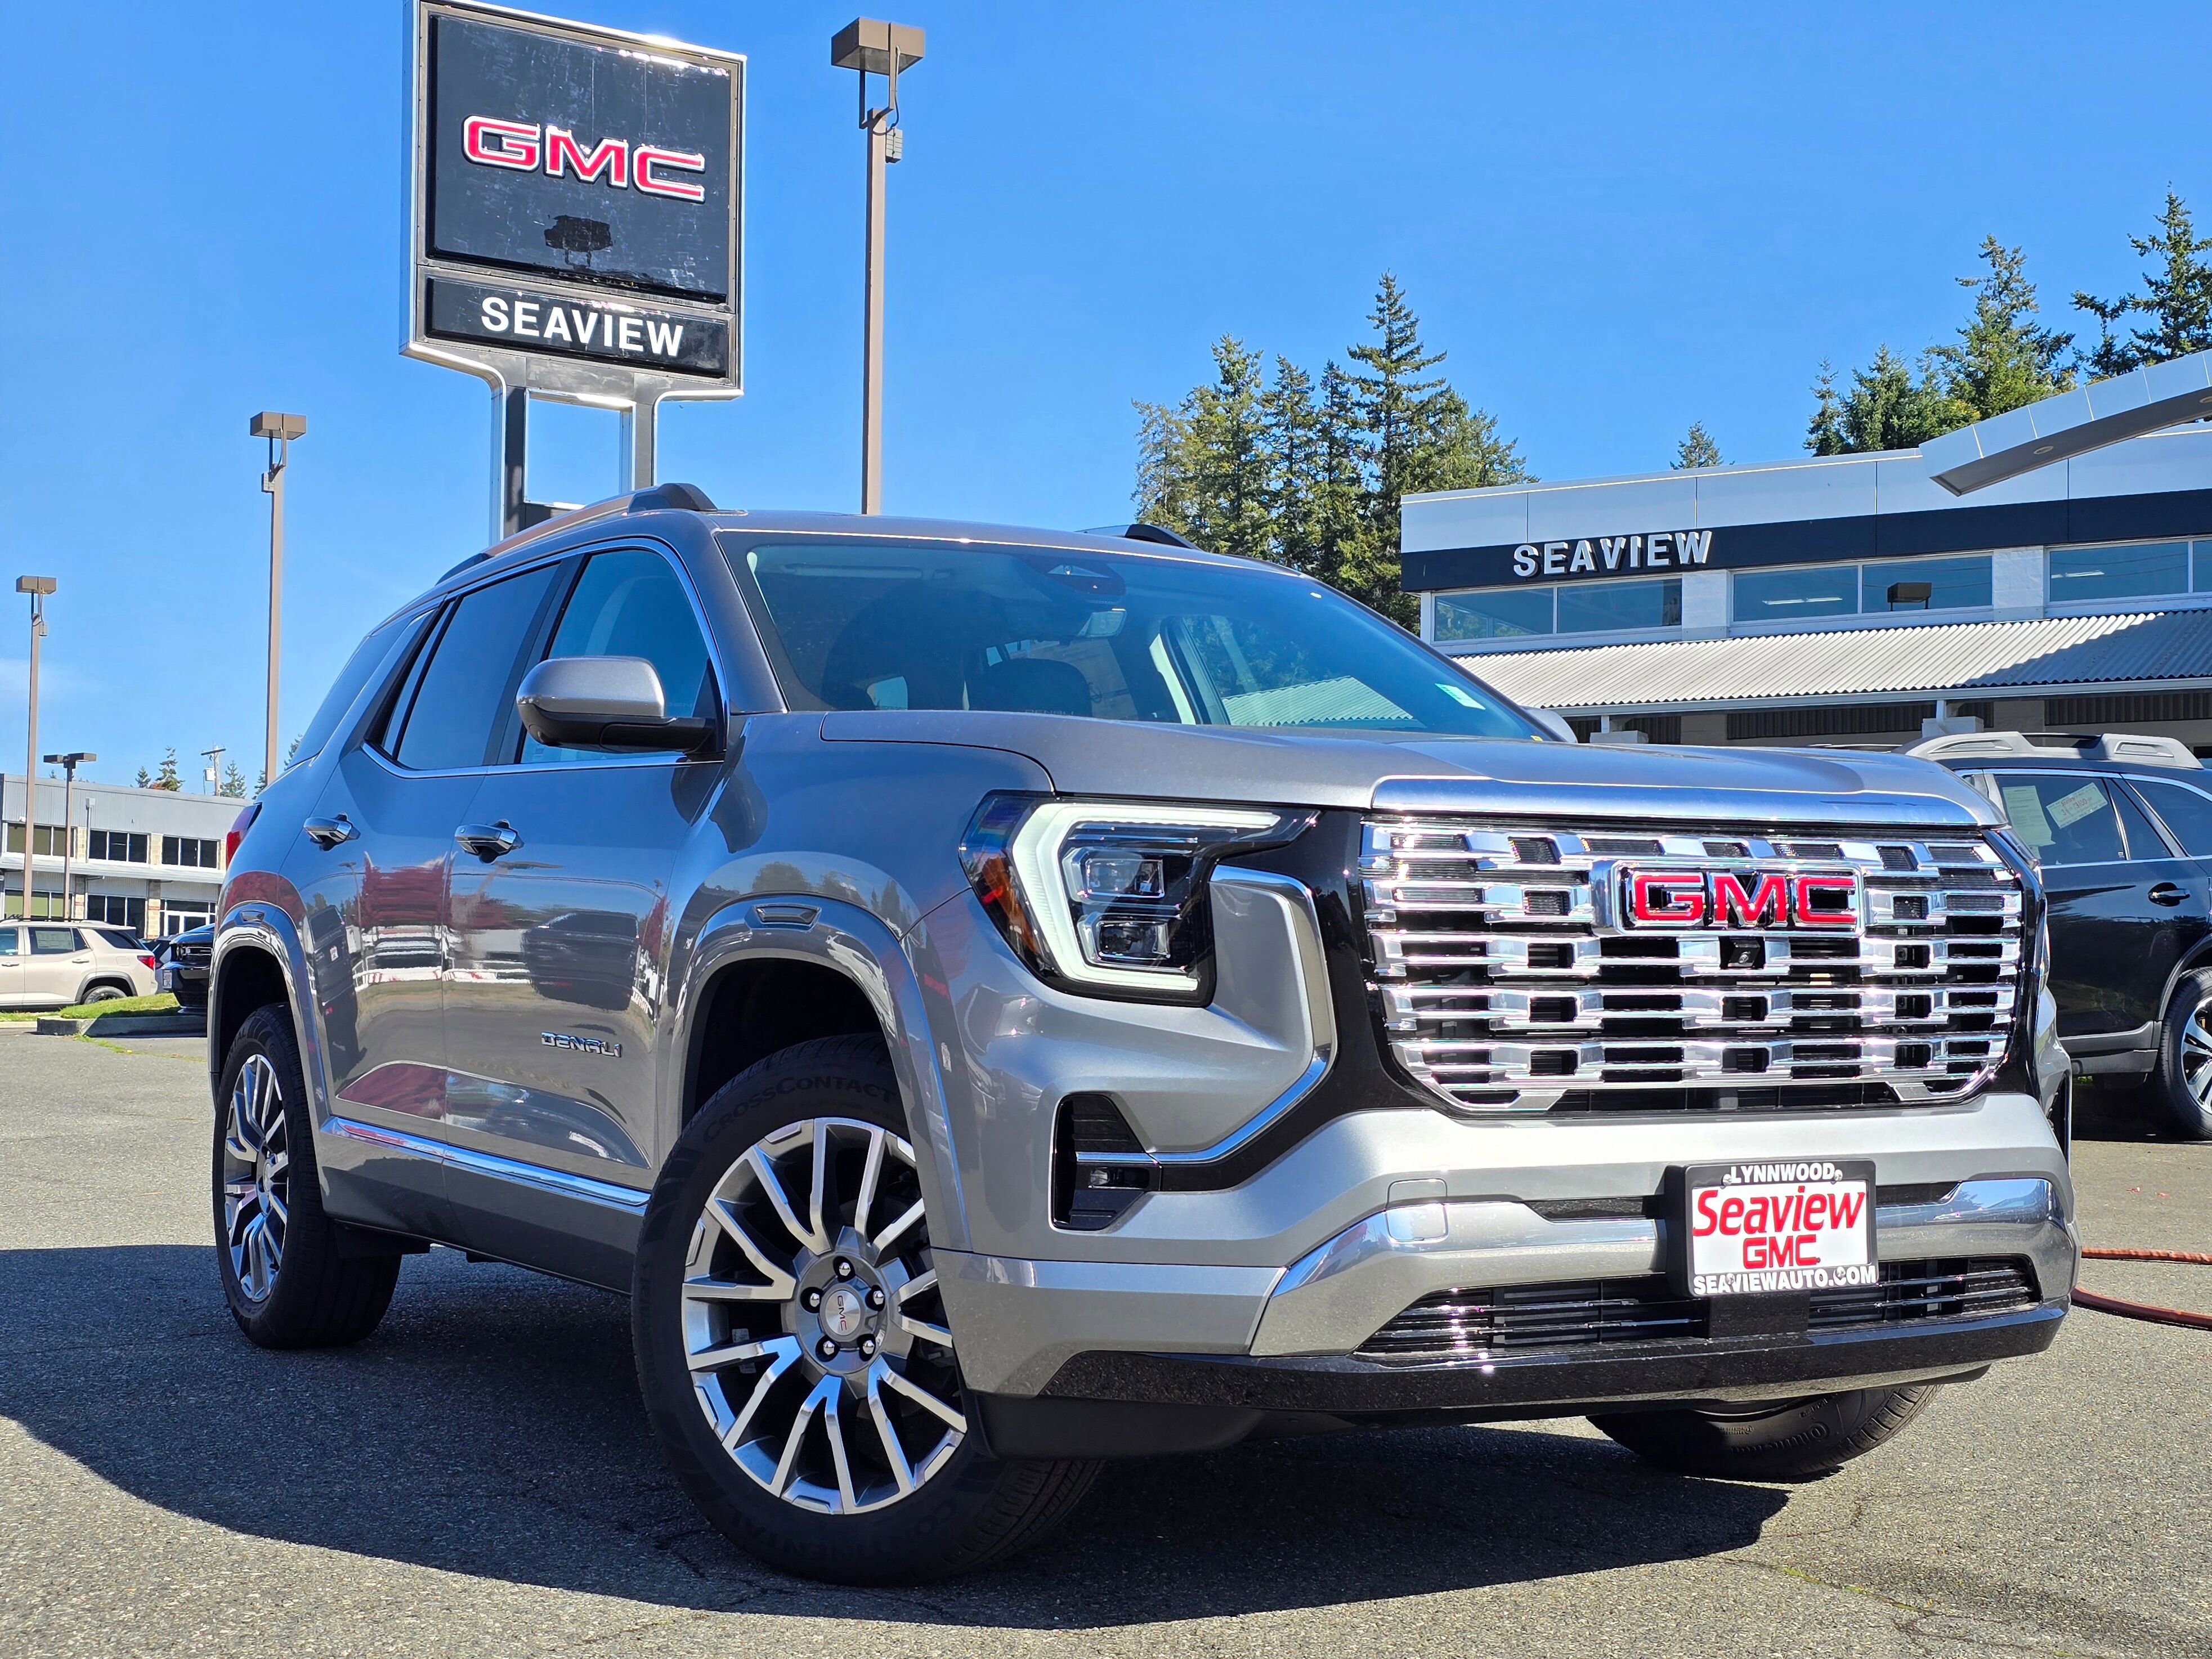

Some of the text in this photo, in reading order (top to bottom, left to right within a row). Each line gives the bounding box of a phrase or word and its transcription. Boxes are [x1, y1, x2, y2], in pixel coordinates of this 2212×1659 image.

[463, 115, 706, 203] GMC
[481, 296, 684, 356] SEAVIEW
[1513, 531, 1712, 577] SEAVIEW
[1633, 873, 1856, 926] GMC
[541, 1032, 622, 1057] DENALI
[1729, 1163, 1835, 1183] LYNNWOOD
[1692, 1186, 1865, 1237] Seaview
[1743, 1234, 1819, 1269] GMC
[1693, 1266, 1877, 1295] SEAVIEWAUTO.COM
[838, 1295, 847, 1331] GMC
